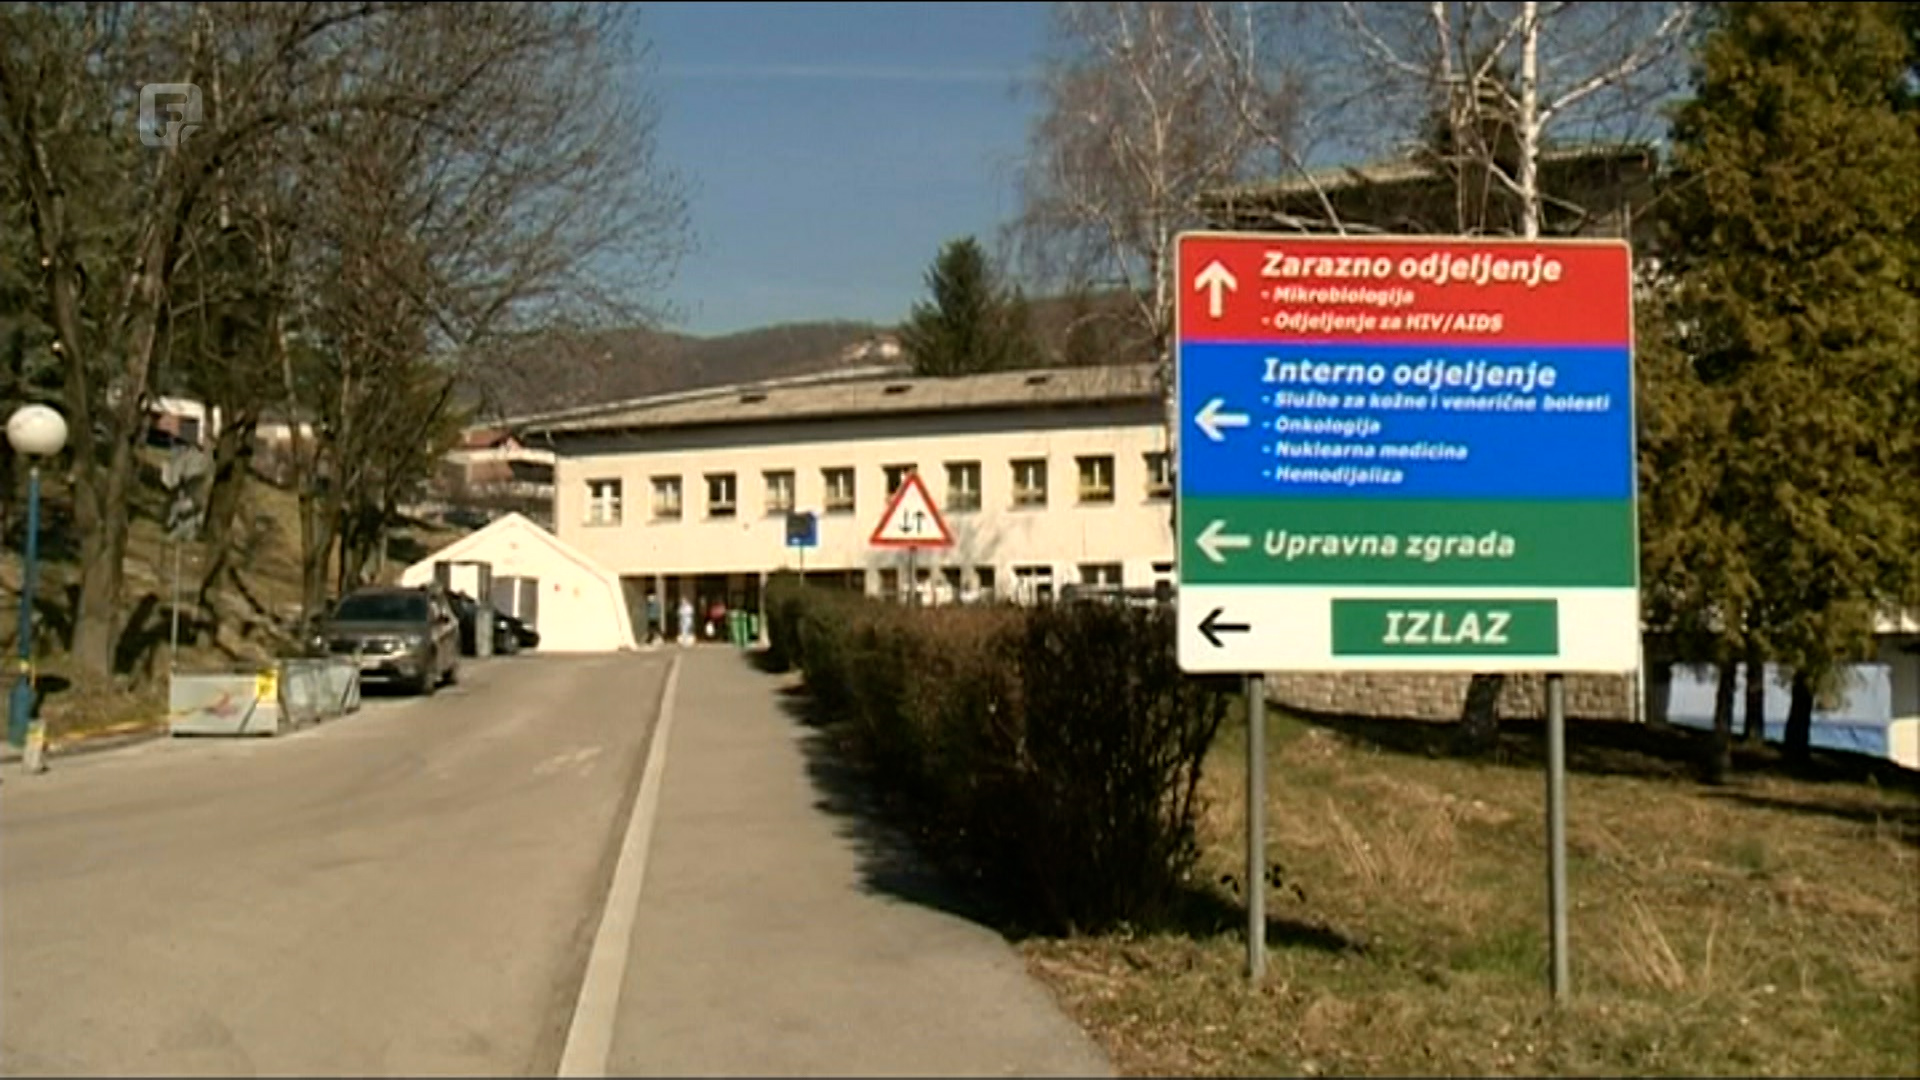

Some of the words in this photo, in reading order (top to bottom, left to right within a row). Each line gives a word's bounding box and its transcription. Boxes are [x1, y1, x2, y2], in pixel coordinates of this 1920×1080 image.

[1262, 251, 1392, 278] Zarazno
[1399, 253, 1561, 286] odjeljenje
[1274, 286, 1414, 307] Mikrobiologija
[1274, 311, 1376, 333] Odjeljenje
[1380, 316, 1401, 329] za
[1406, 314, 1502, 332] HIV/AIDS
[1263, 358, 1385, 384] Interno
[1393, 361, 1556, 390] odjeljenje
[1343, 396, 1365, 408] za
[1369, 393, 1427, 409] kožne
[1442, 391, 1536, 411] venerične
[1543, 393, 1609, 411] bolesti
[1276, 416, 1380, 437] Onkologija
[1277, 442, 1376, 457] Nuklearna
[1379, 444, 1467, 459] medicina
[1276, 468, 1403, 485] Hemodijaliza
[1264, 531, 1398, 560] Upravna
[1405, 531, 1515, 562] zgrada
[1383, 612, 1510, 644] IZLAZ
